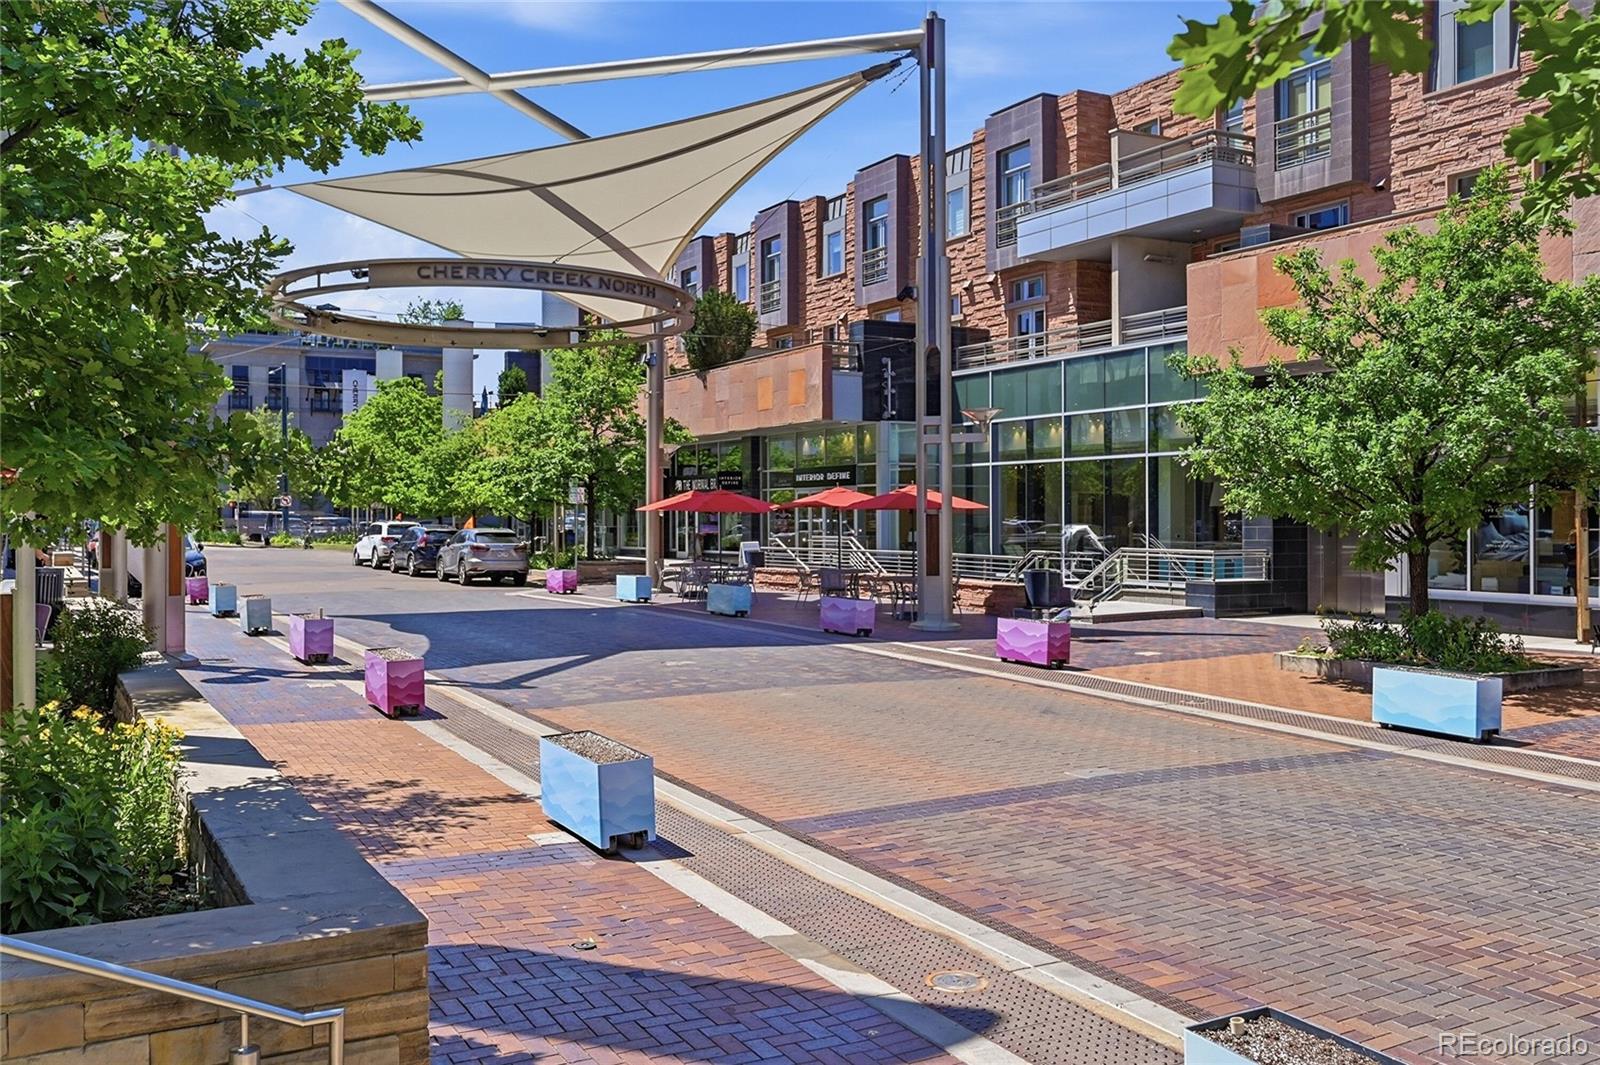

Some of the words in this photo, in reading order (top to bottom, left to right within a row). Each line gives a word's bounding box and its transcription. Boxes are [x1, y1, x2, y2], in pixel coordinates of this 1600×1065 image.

[417, 265, 513, 281] CHERRY
[520, 268, 593, 288] CREEK
[599, 276, 657, 299] NORTH
[795, 472, 825, 482] INTERIOR
[826, 471, 851, 480] DEFINE
